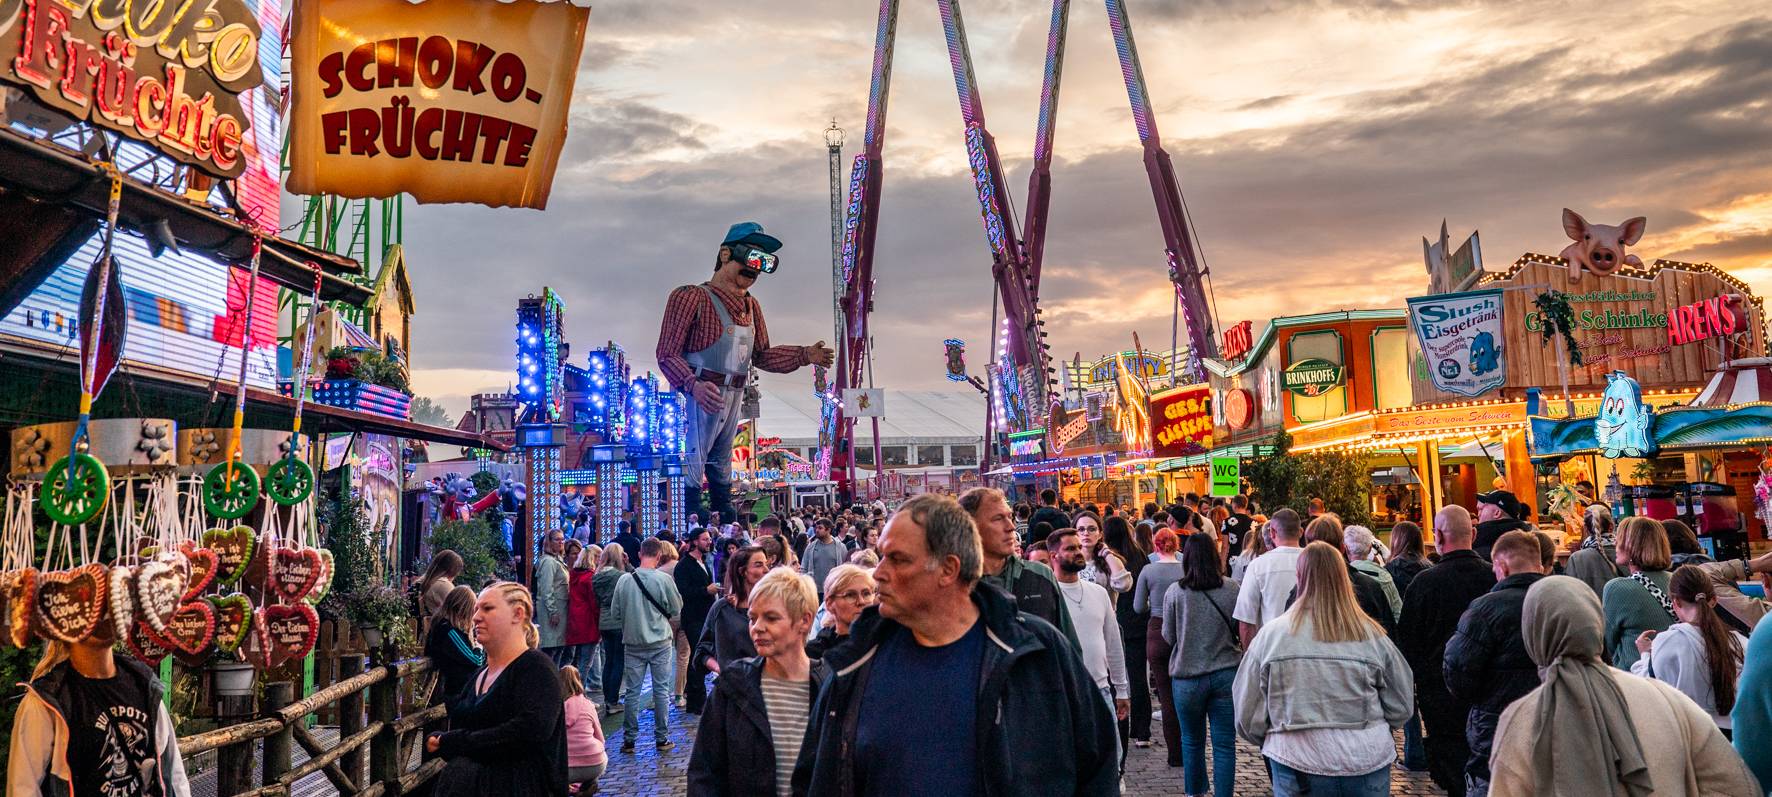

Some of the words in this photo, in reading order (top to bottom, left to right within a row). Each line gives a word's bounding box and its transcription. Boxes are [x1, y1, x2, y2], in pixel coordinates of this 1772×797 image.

[318, 35, 543, 104] SCHOKO-
[14, 0, 242, 171] Früchte
[322, 95, 538, 168] FRÜCHTE
[1563, 290, 1657, 303] estfälischer
[1418, 299, 1494, 323] Slush
[1420, 309, 1498, 339] Eisgetränk
[1667, 294, 1735, 345] ARENS
[1223, 320, 1251, 359] ARENS
[1617, 344, 1671, 359] Schwein
[1390, 417, 1409, 428] Das
[1414, 415, 1441, 426] Beste
[1469, 410, 1512, 422] Schwein
[1213, 464, 1238, 477] WC
[94, 705, 149, 732] RURPOTT
